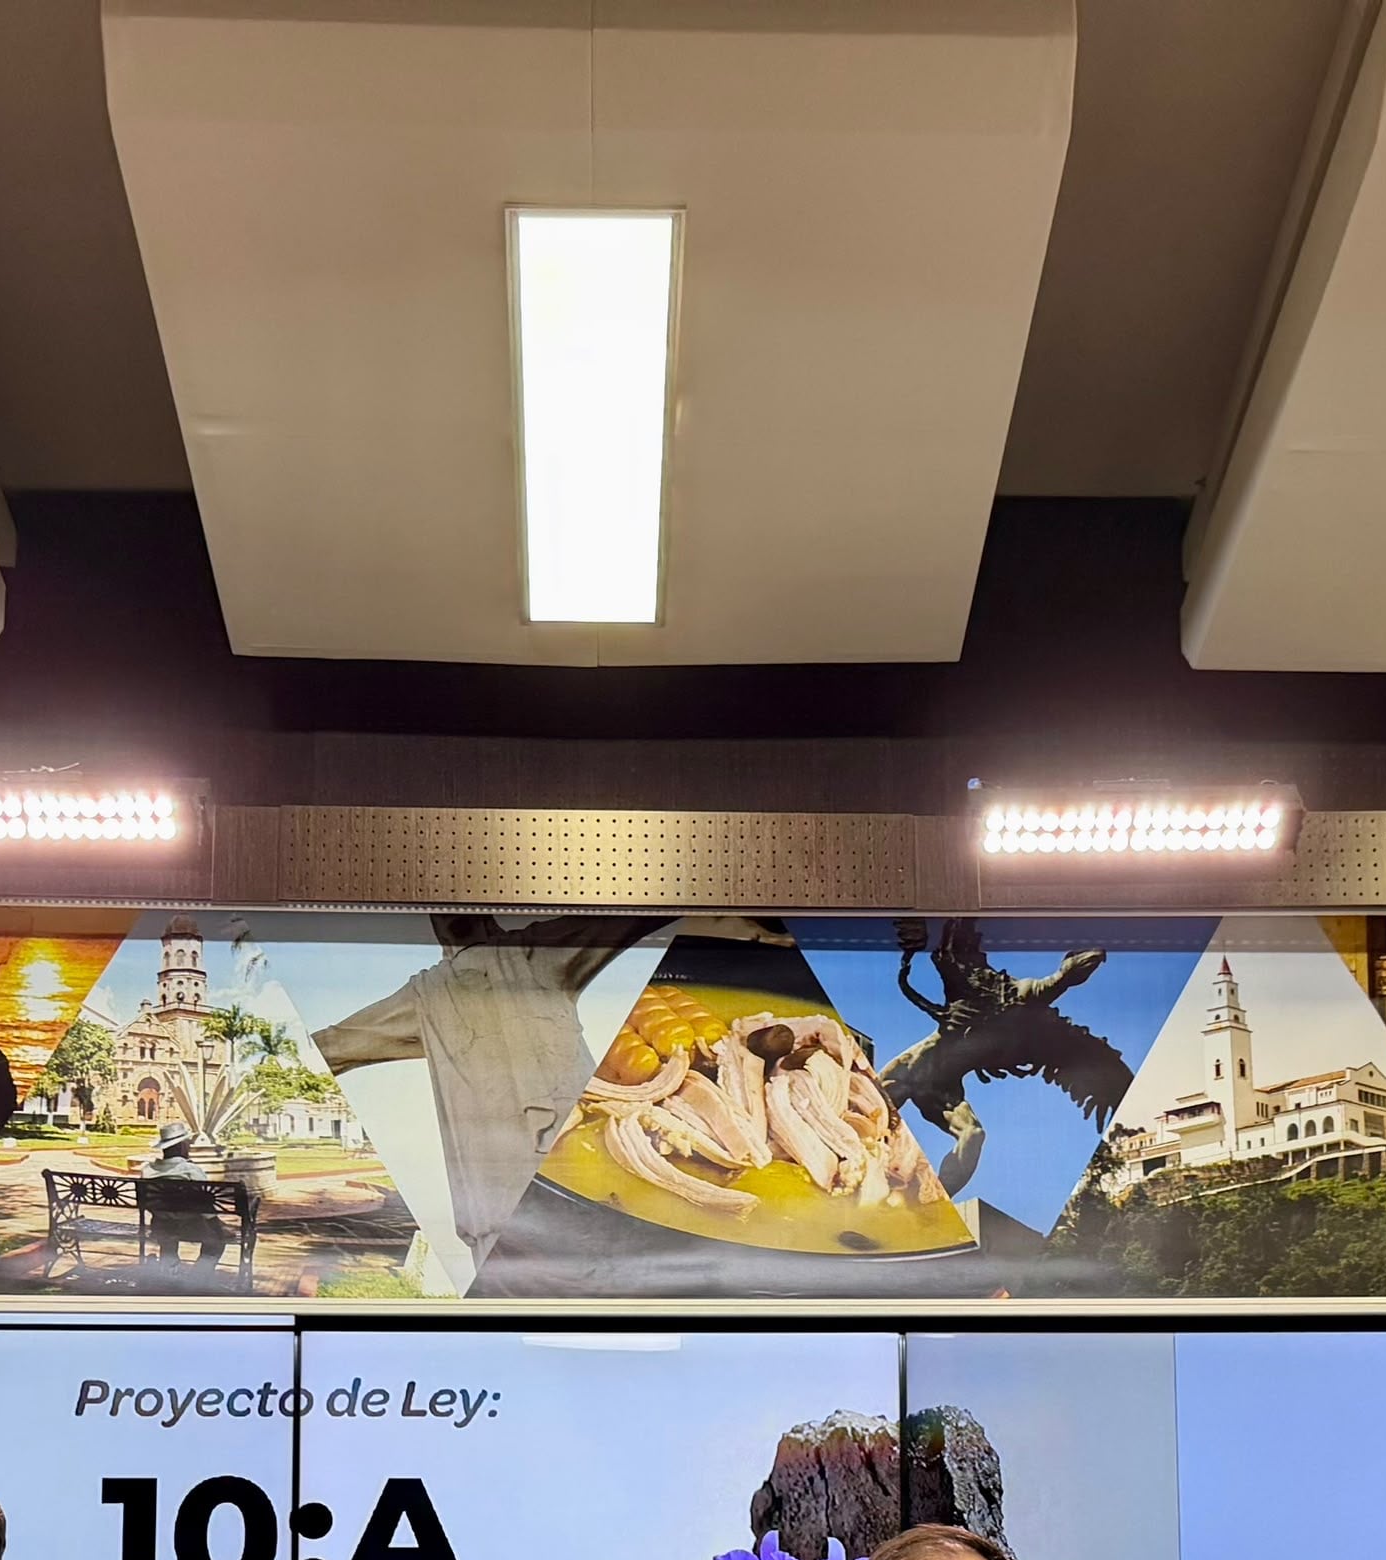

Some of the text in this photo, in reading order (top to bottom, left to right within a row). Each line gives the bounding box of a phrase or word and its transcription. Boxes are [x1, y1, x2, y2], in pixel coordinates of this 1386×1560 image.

[75, 1377, 501, 1429] Proyecto de Ley:
